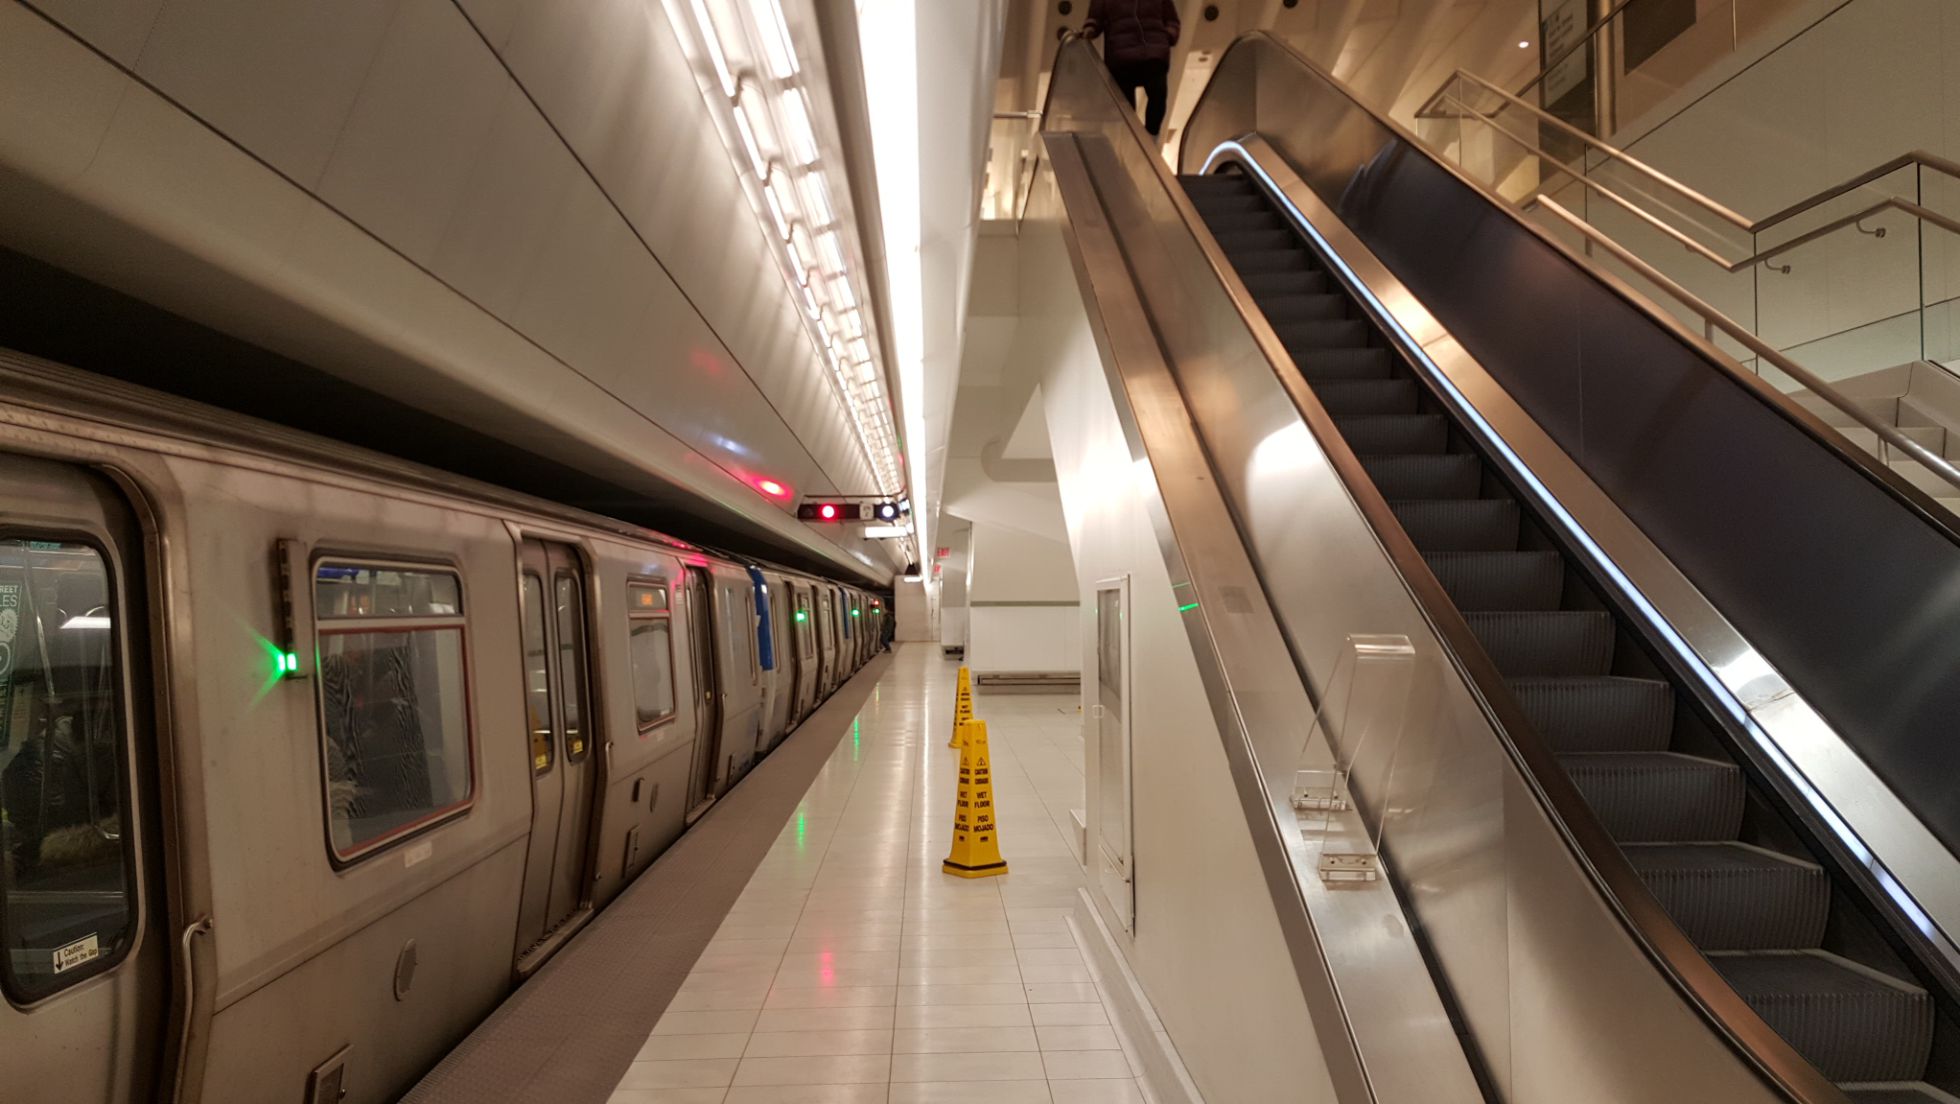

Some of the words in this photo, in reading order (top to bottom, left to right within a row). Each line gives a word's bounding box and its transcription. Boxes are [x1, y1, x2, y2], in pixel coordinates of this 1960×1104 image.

[976, 791, 987, 799] WET
[974, 800, 990, 809] FLOOR
[977, 815, 989, 823] PISO
[973, 823, 994, 833] MOJADO
